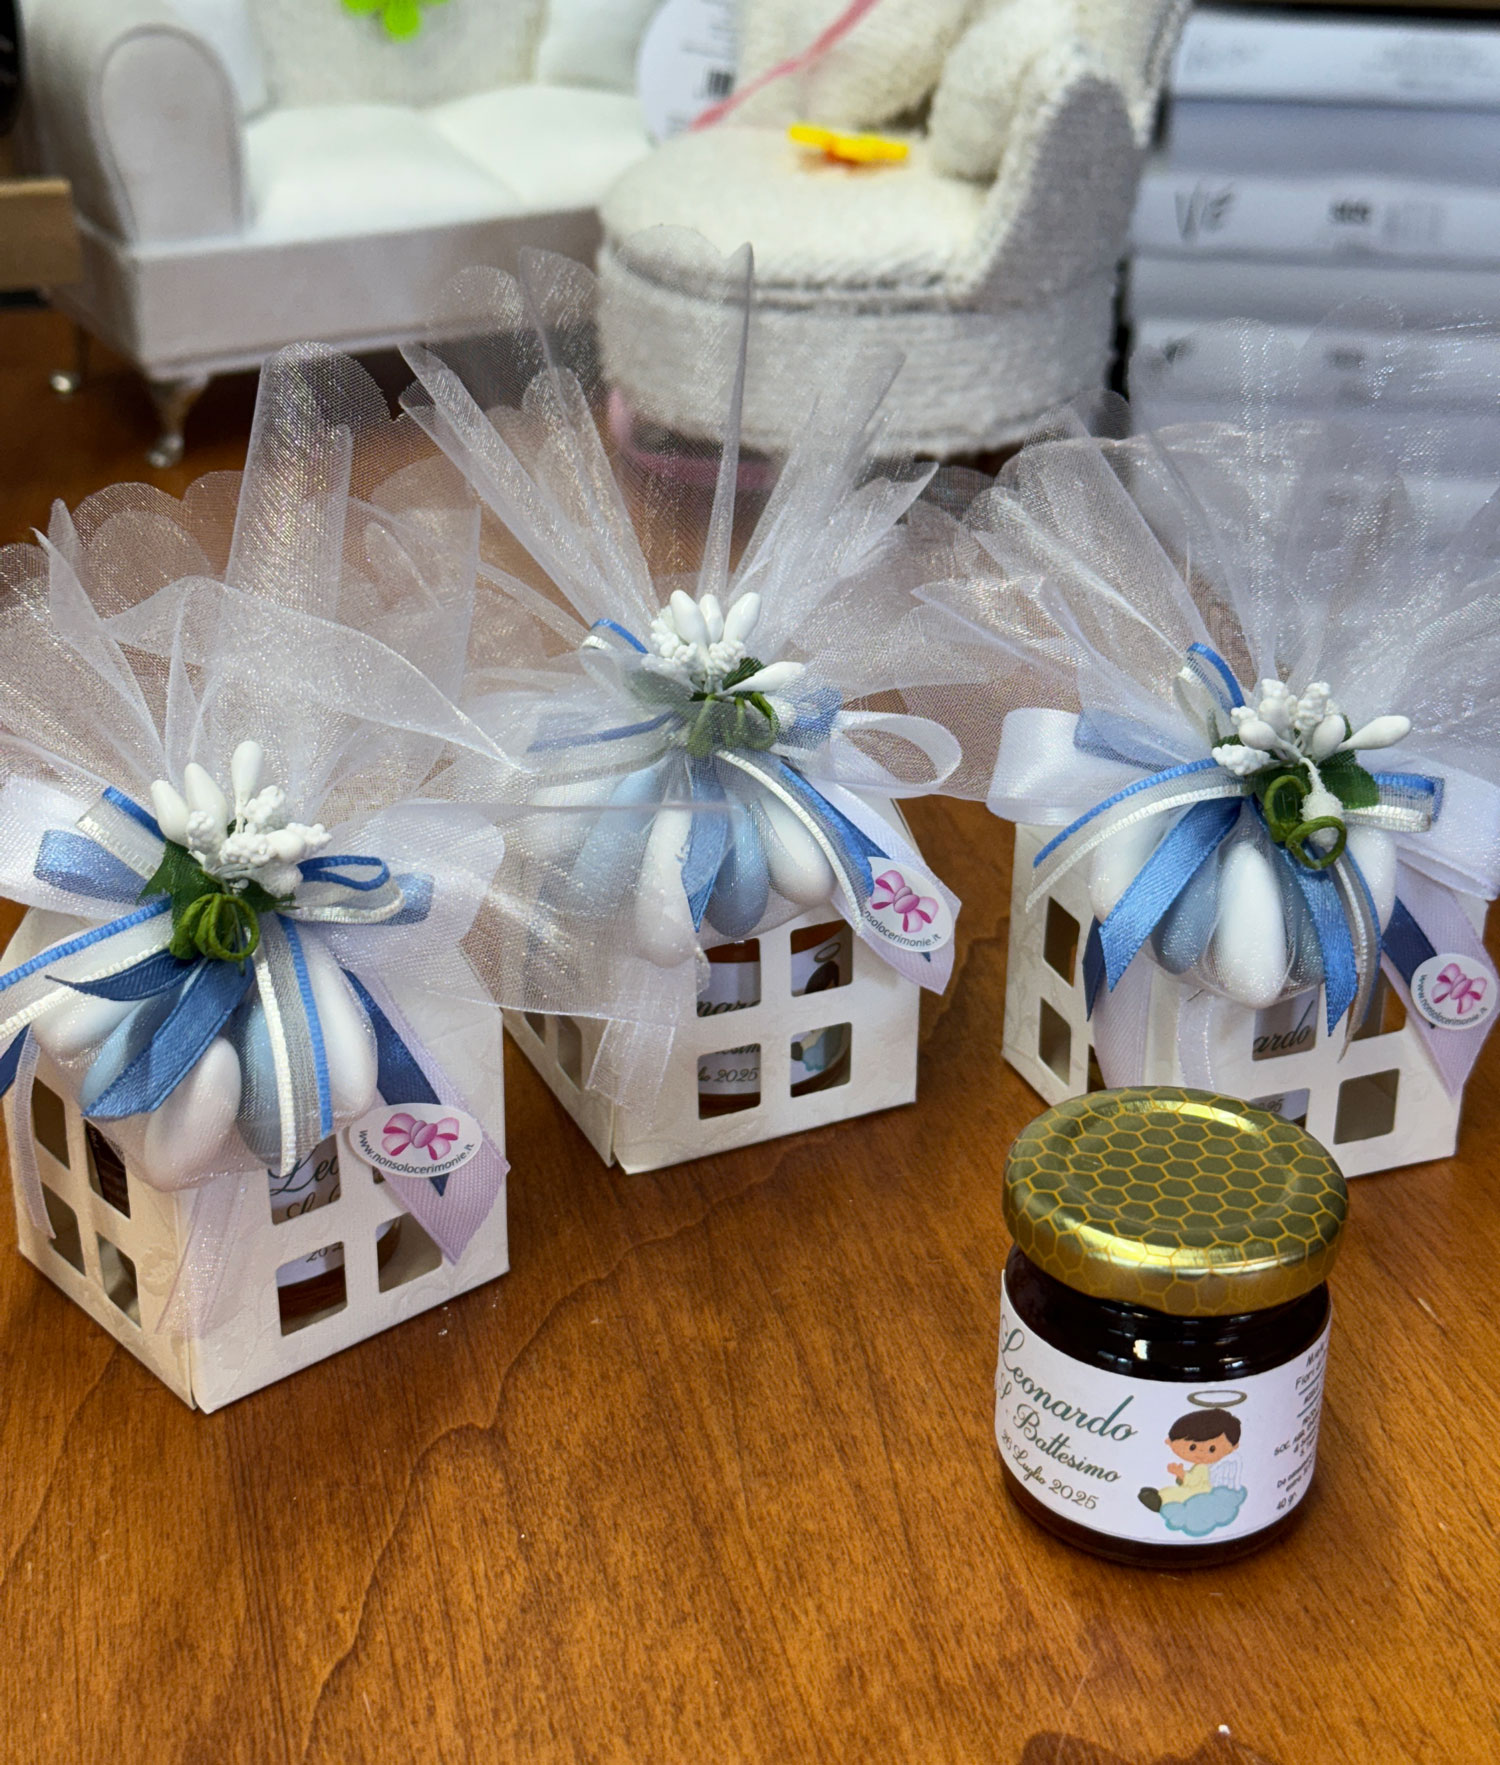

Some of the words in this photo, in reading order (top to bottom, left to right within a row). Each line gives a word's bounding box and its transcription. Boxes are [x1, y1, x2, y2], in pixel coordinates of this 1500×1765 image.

[713, 1066, 761, 1083] 2025
[359, 1129, 475, 1175] www.nonsolocerimonie.it
[1000, 1313, 1138, 1441] Leonardo
[1013, 1403, 1121, 1483] Battesimo
[1012, 1444, 1046, 1485] Luglio
[1048, 1478, 1099, 1510] 2025
